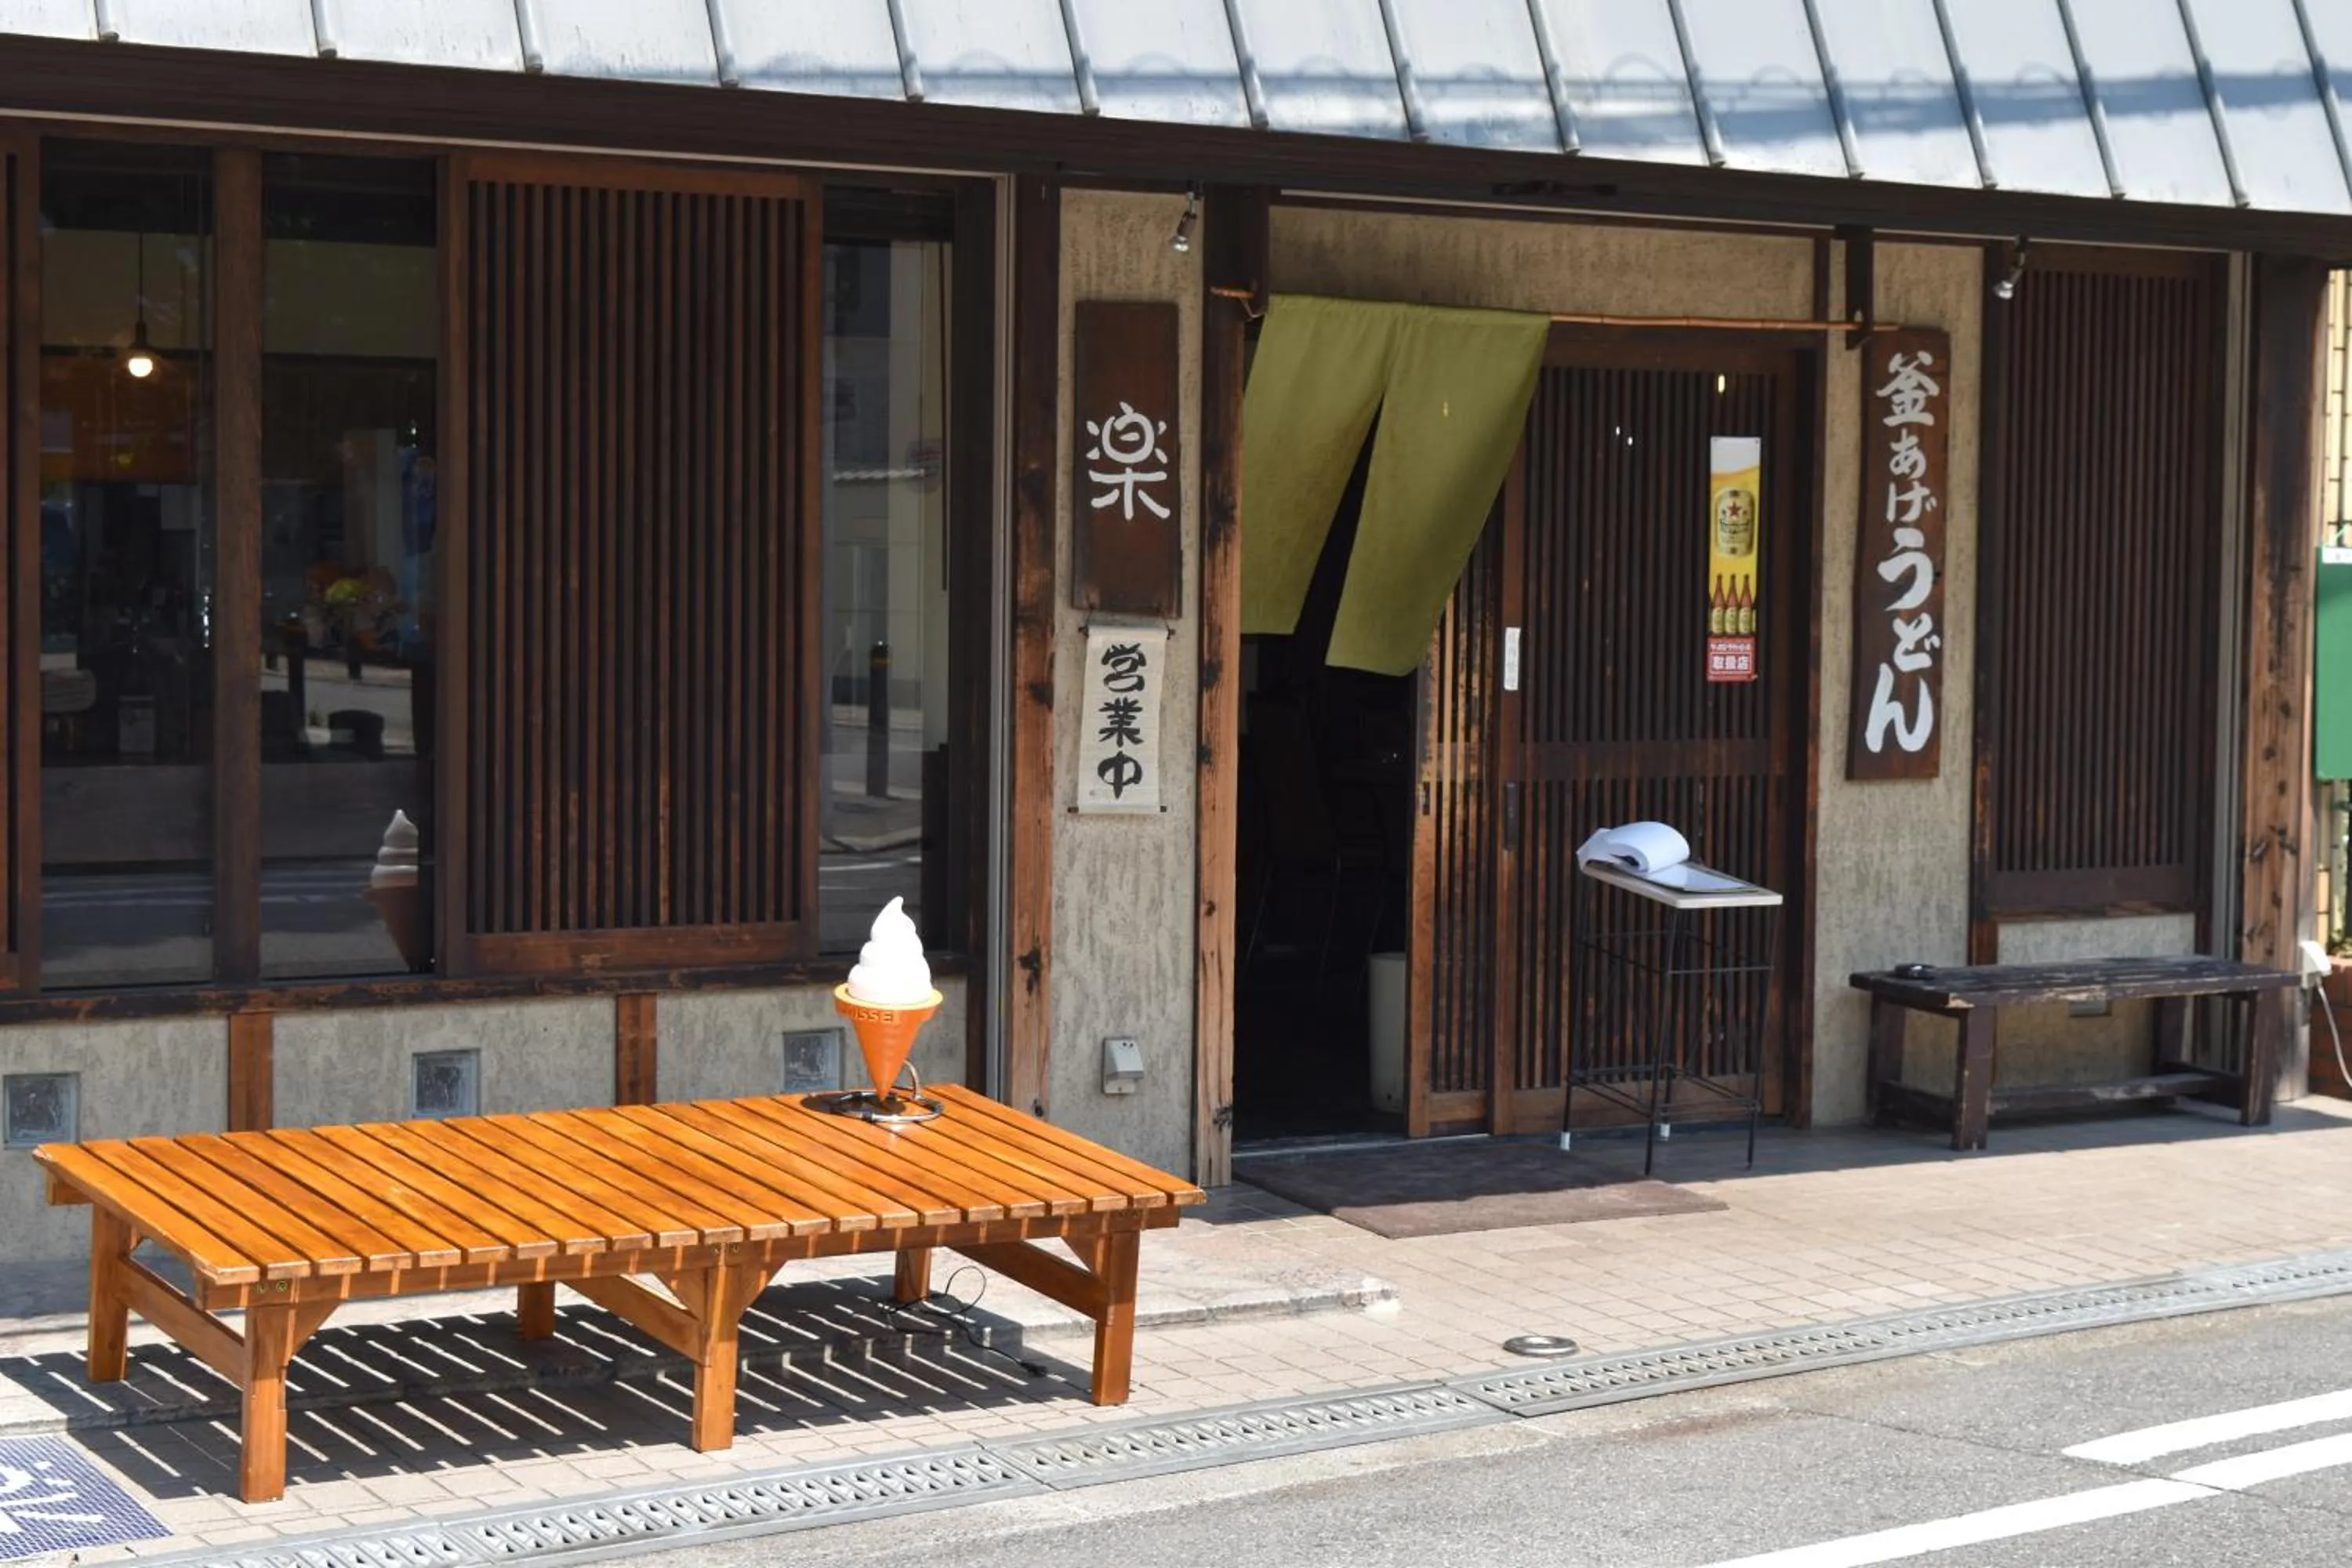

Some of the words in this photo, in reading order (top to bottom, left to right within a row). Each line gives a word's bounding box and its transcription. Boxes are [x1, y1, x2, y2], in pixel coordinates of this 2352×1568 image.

[1086, 401, 1171, 520] 楽
[1864, 350, 1940, 753] 釜あげうどん
[1097, 642, 1147, 800] 営業中
